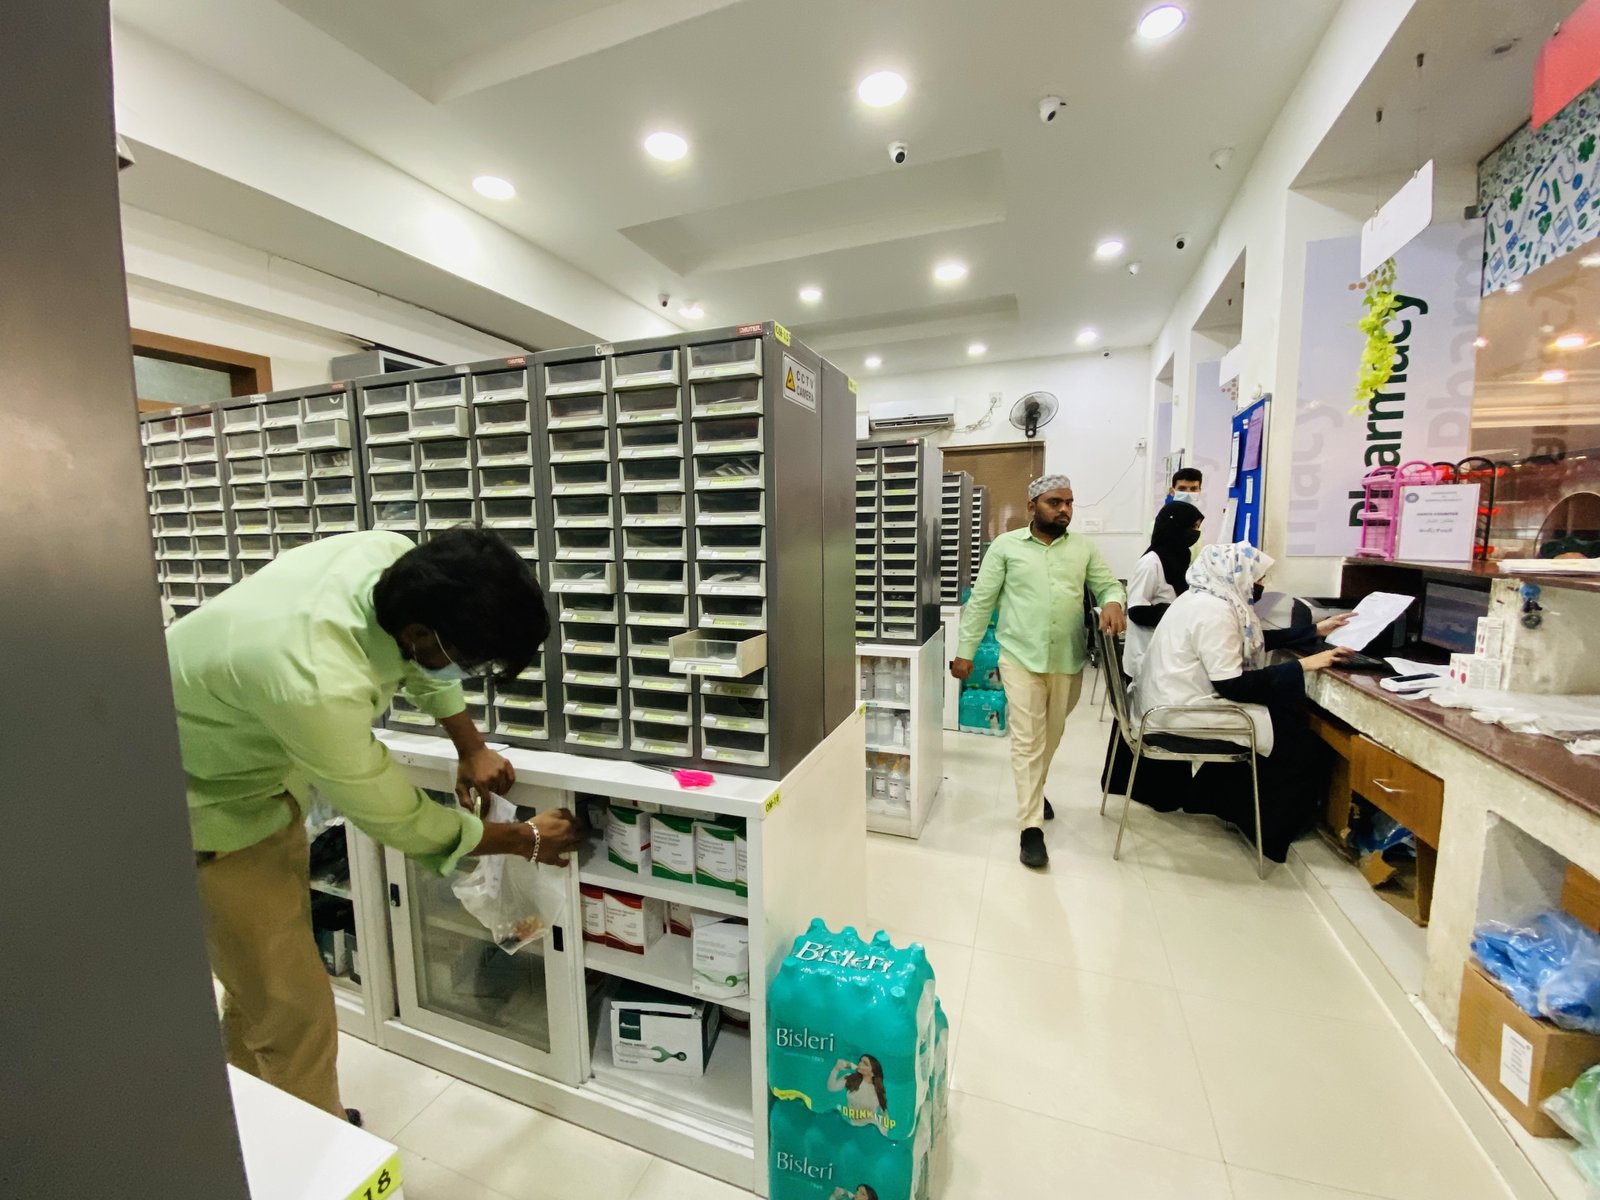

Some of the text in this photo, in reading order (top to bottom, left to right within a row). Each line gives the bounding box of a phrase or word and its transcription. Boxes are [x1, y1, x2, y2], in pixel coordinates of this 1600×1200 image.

[796, 370, 814, 389] CCTV
[796, 385, 815, 402] CAMERA
[795, 940, 895, 973] Bisleri
[775, 1027, 835, 1051] Bisleri
[842, 1105, 873, 1120] DRINK
[883, 1117, 896, 1129] UP
[776, 1151, 833, 1180] Bisleri
